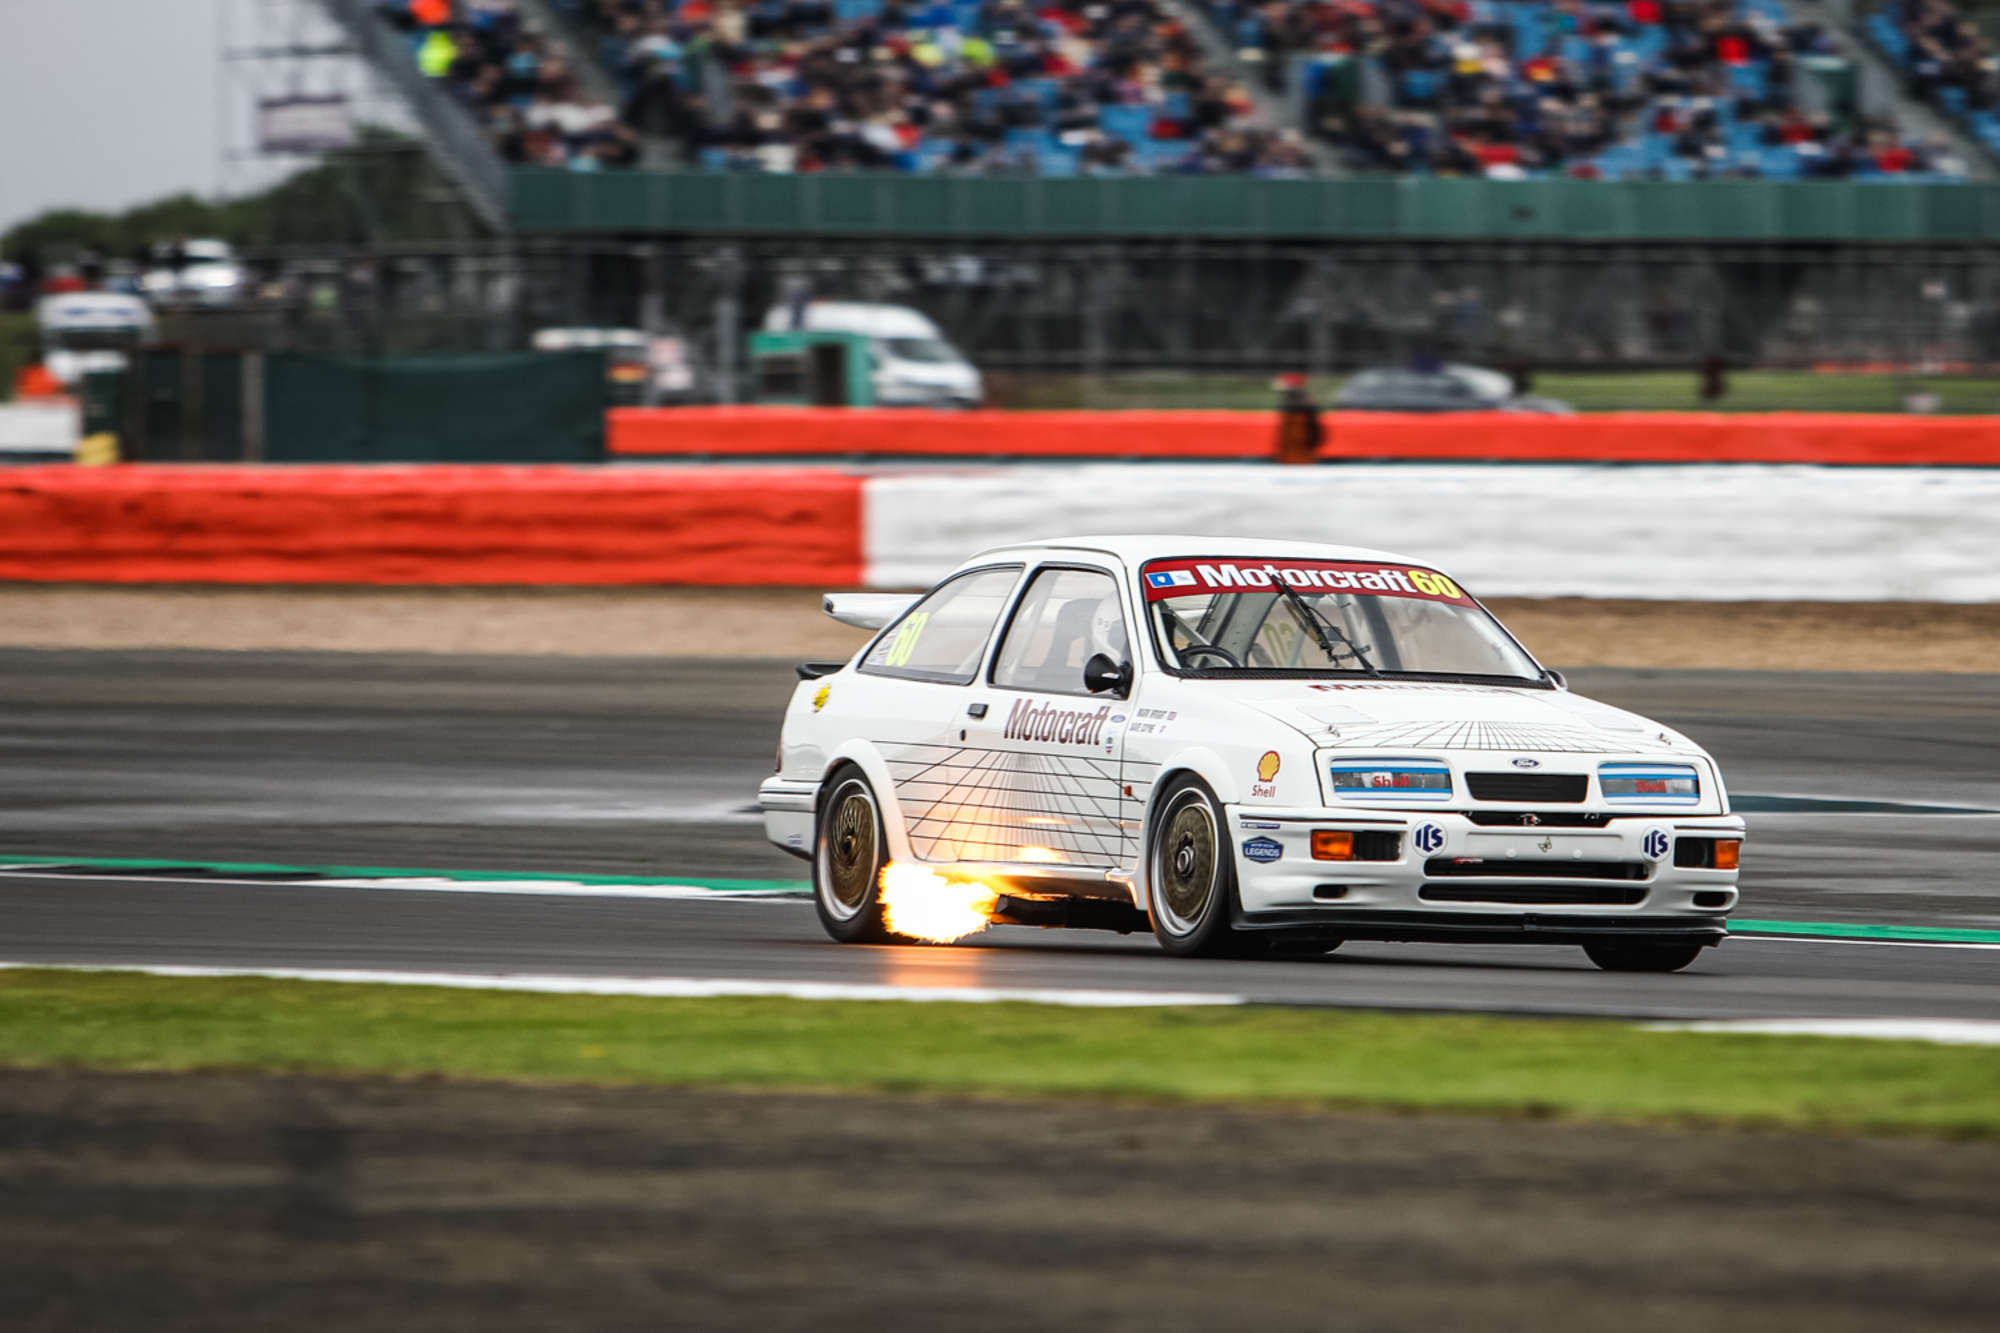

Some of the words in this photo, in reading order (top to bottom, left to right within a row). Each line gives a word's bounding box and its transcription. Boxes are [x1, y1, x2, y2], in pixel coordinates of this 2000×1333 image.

[1195, 564, 1418, 593] Motorcraft
[1407, 569, 1462, 599] 60
[885, 611, 929, 666] 60
[1004, 699, 1112, 746] Motorcraft
[1251, 784, 1277, 798] Shell
[1372, 775, 1410, 788] Shell
[1244, 847, 1281, 857] LEGENDS
